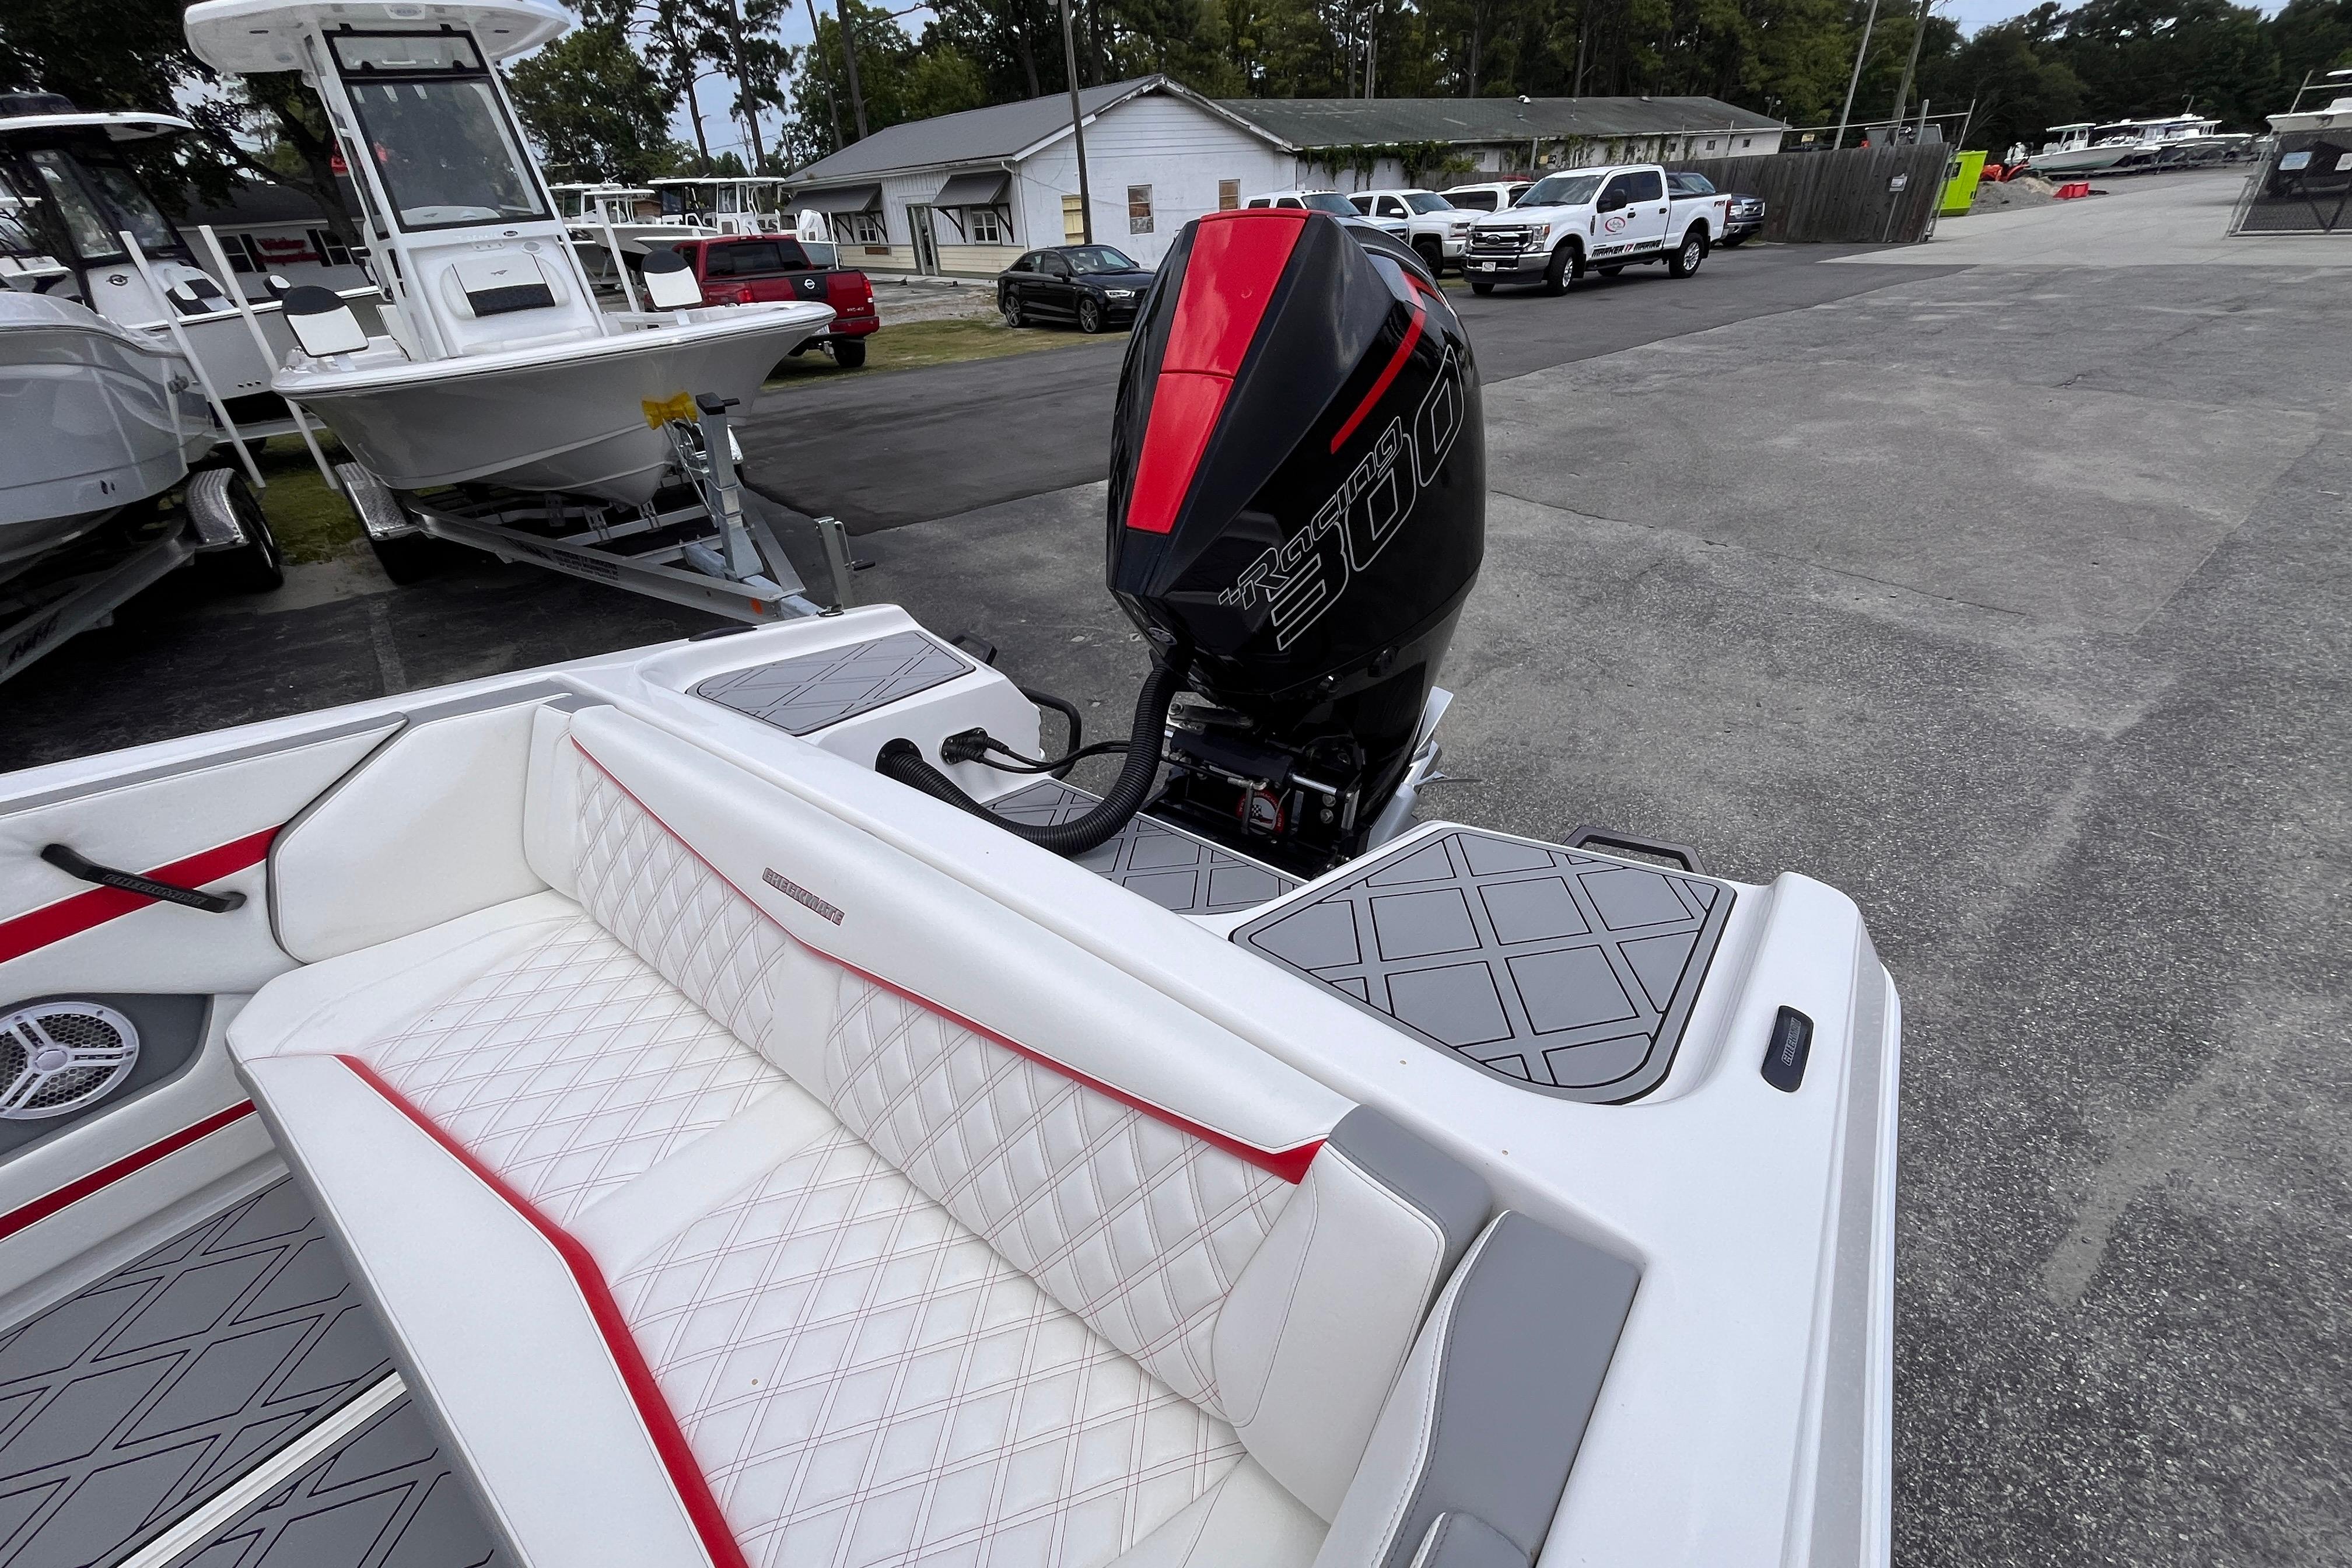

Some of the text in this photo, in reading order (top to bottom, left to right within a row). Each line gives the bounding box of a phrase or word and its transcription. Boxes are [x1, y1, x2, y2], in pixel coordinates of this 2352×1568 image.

[1625, 243, 1634, 252] 17
[1238, 416, 1402, 610] Racing
[762, 867, 845, 926] CHECKMATE
